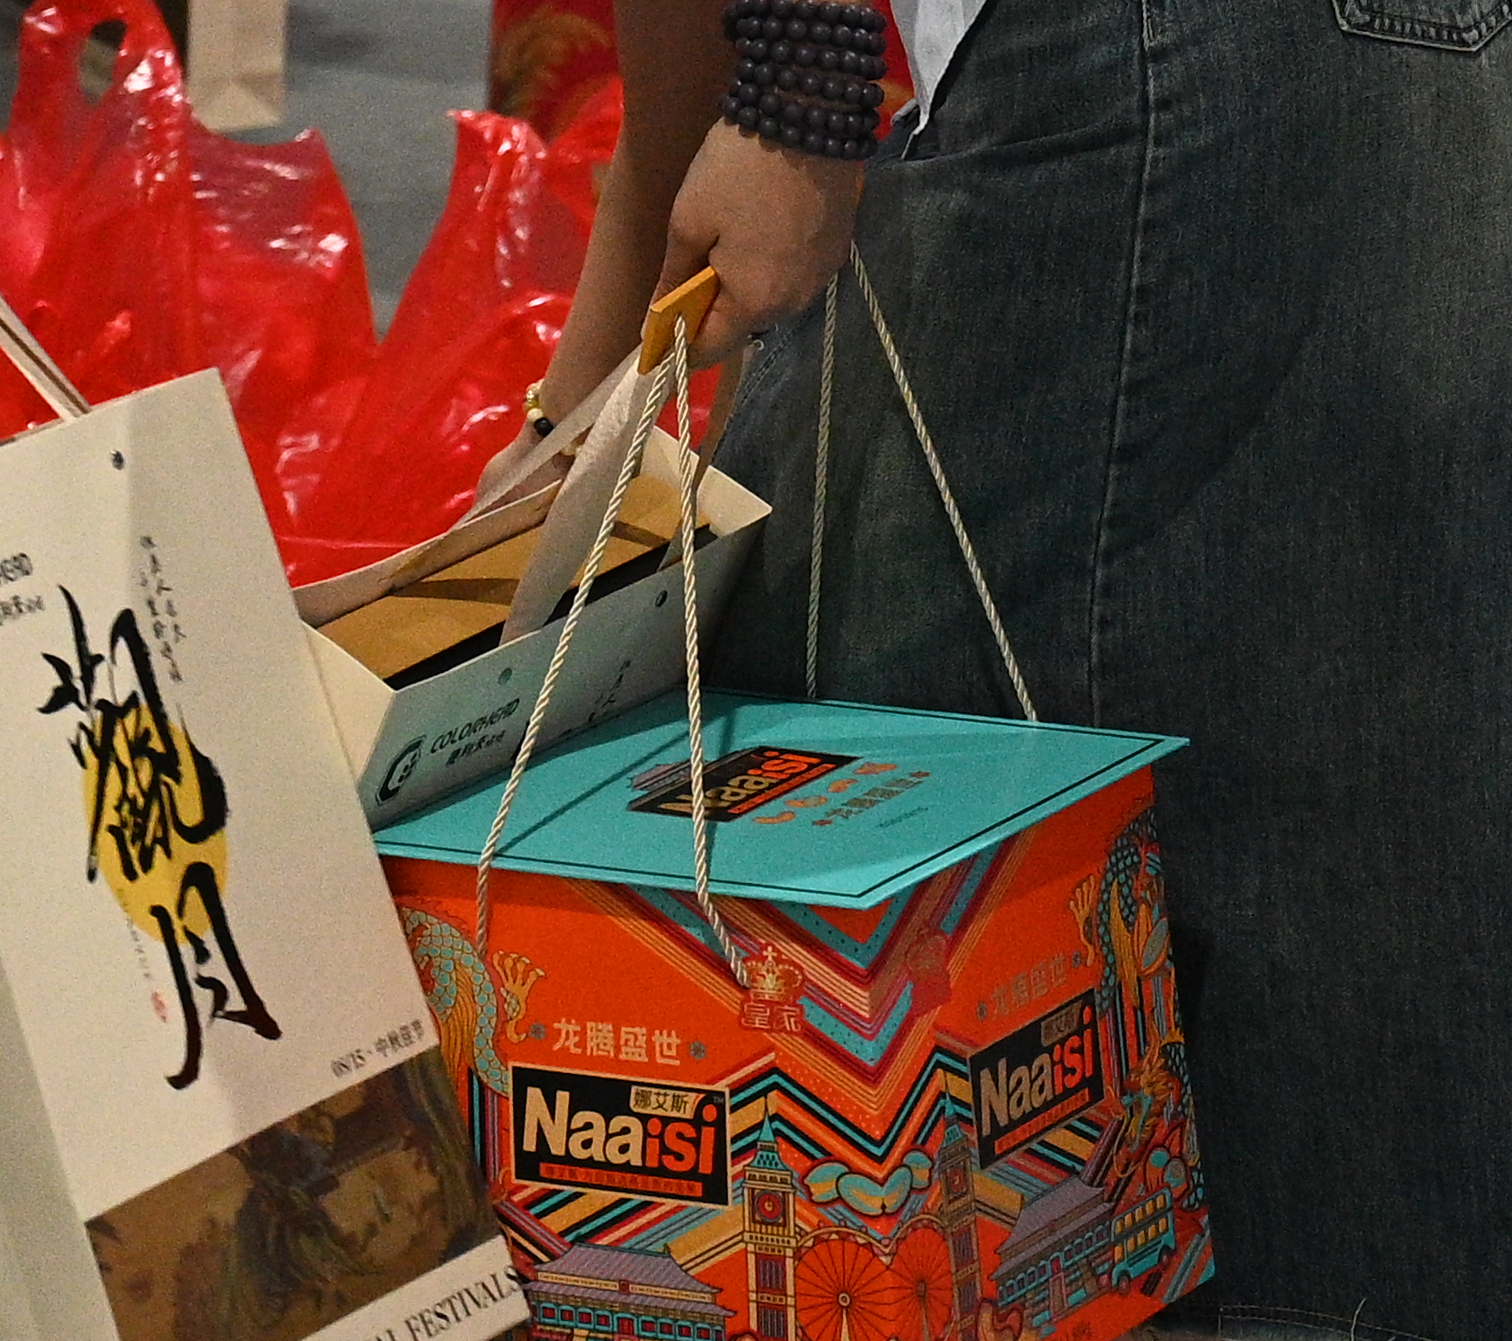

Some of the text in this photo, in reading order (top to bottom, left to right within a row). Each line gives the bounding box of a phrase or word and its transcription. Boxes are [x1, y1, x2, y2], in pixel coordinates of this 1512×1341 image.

[552, 1017, 681, 1066] 龙腾盛世
[979, 1005, 1094, 1137] Naaisi
[522, 1085, 718, 1176] Naaisi
[633, 1090, 689, 1115] 娜艾斯
[404, 1267, 521, 1341] FESTIVALS
